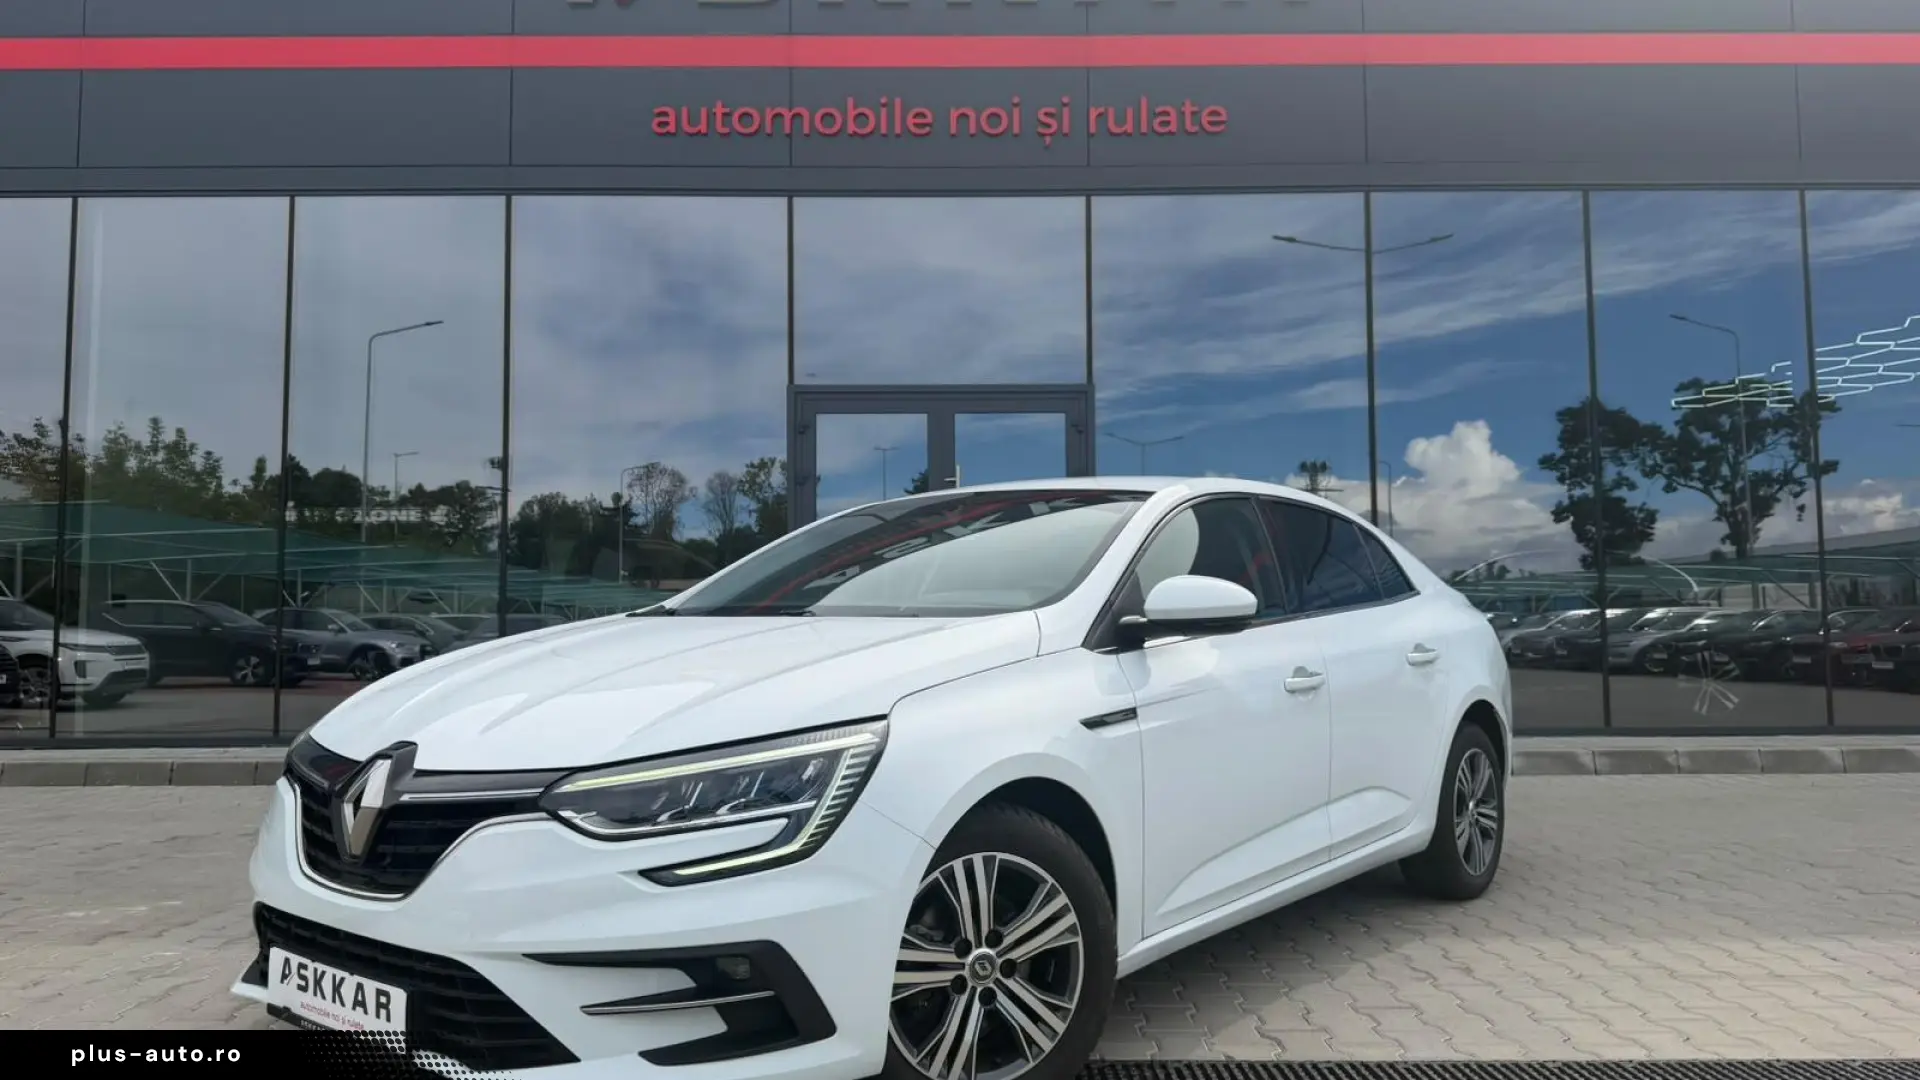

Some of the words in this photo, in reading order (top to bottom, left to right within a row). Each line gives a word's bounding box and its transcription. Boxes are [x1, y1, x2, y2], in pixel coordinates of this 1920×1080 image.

[651, 97, 934, 136] automobile
[949, 95, 1020, 137] noi
[1036, 95, 1071, 147] și
[1088, 95, 1229, 136] rulate
[279, 956, 392, 1023] ASKKAR
